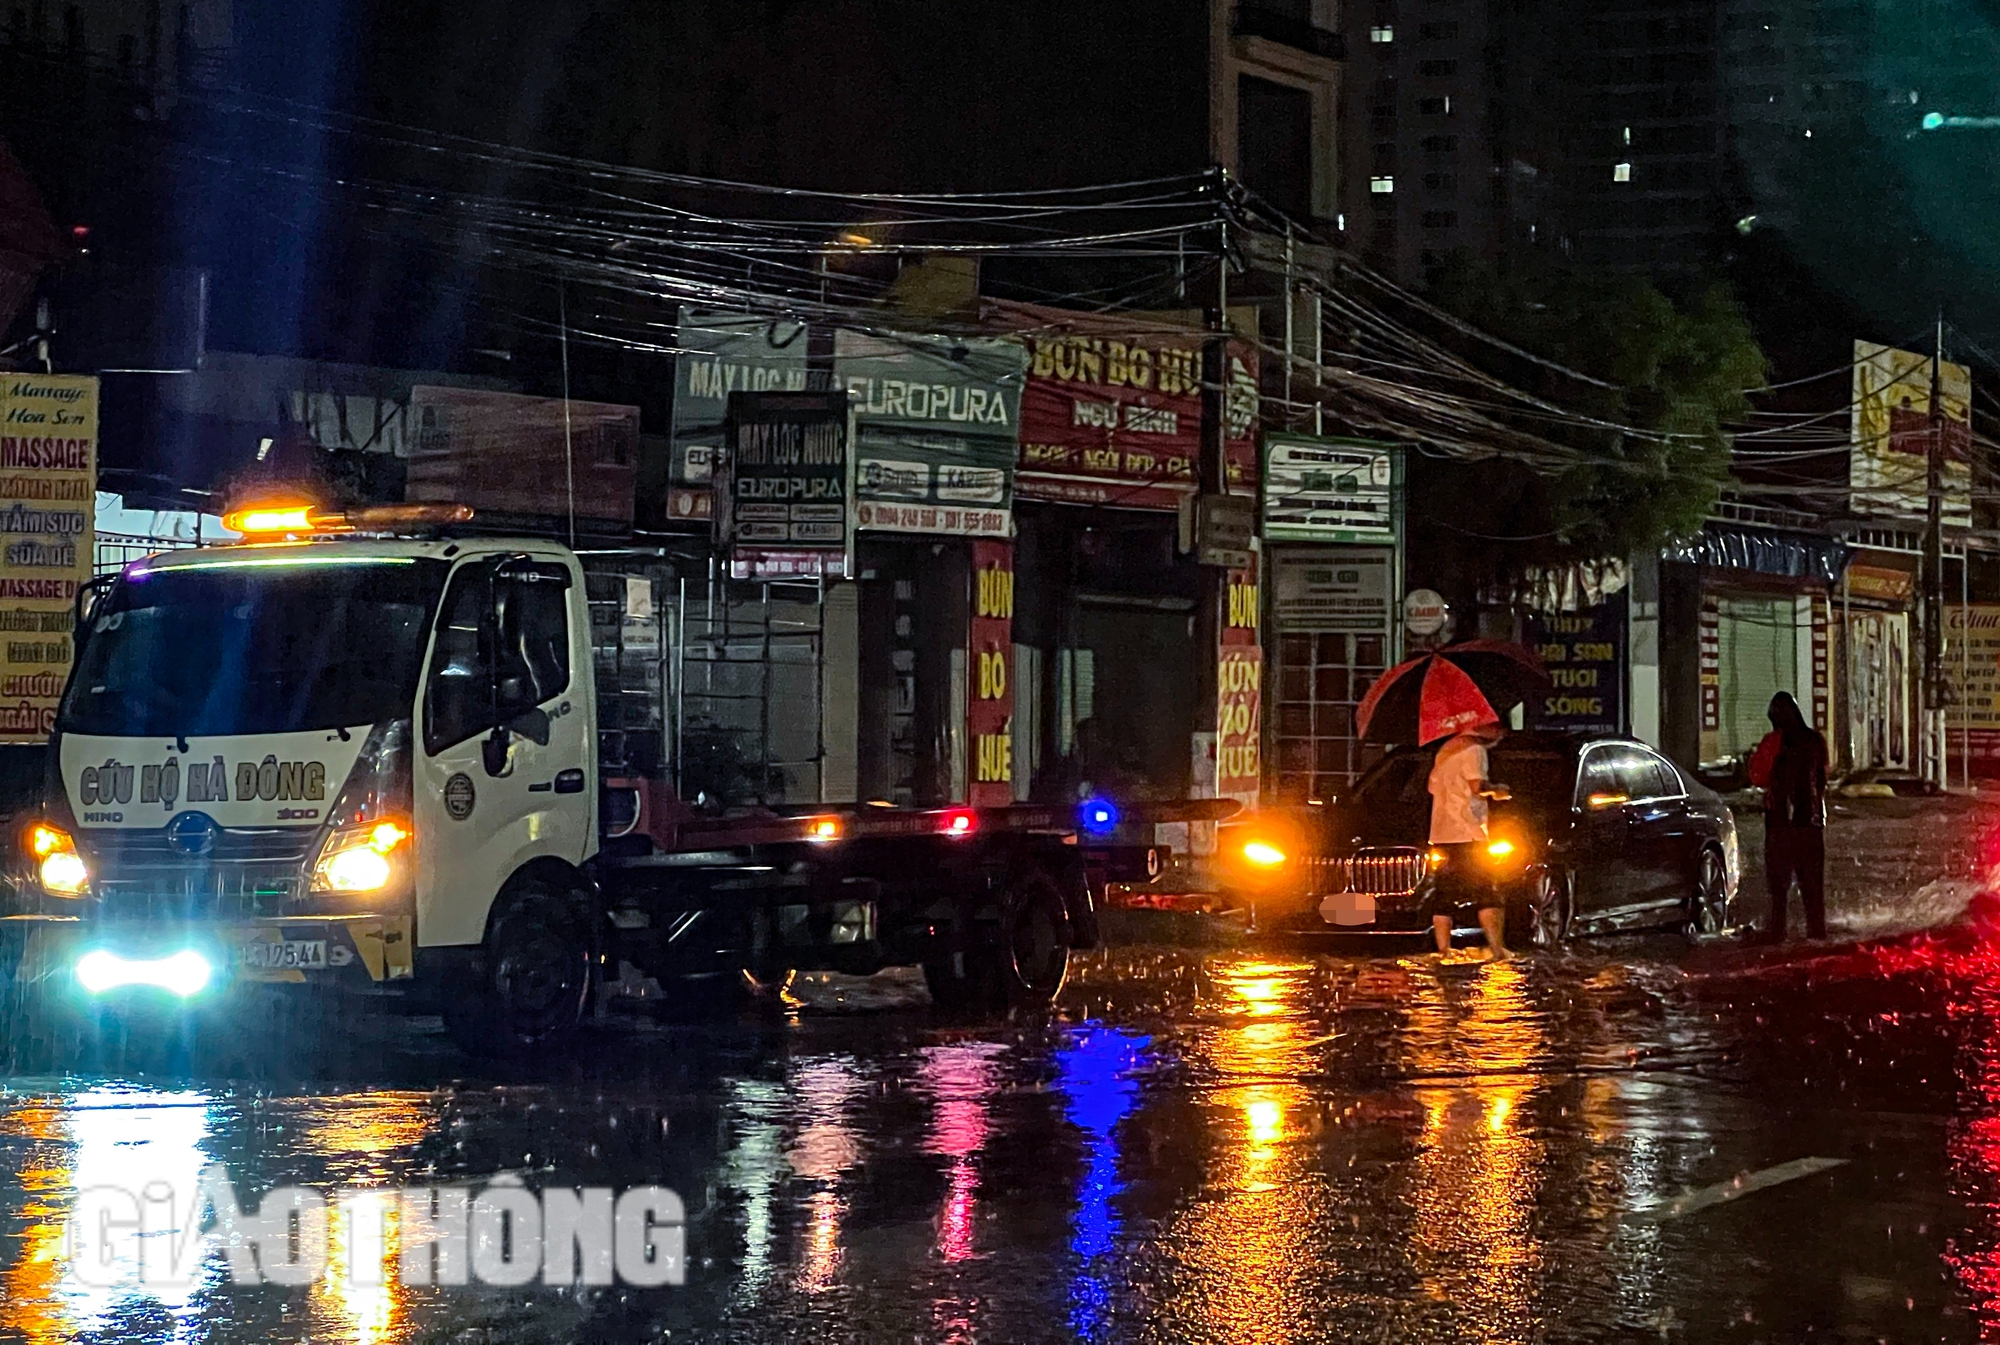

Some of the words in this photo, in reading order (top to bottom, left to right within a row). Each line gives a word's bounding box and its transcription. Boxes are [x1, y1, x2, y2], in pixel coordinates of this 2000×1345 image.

[848, 376, 1008, 425] EUROPURA
[1, 437, 88, 469] MASSAGE
[737, 477, 843, 499] EUROPURA
[0, 579, 62, 598] MASSAGE
[80, 758, 134, 805] CỨU
[141, 756, 180, 811] HỘ
[187, 755, 229, 803] HÀ
[236, 755, 326, 801] ĐÔNG
[83, 811, 124, 823] HINO
[277, 808, 319, 820] 300
